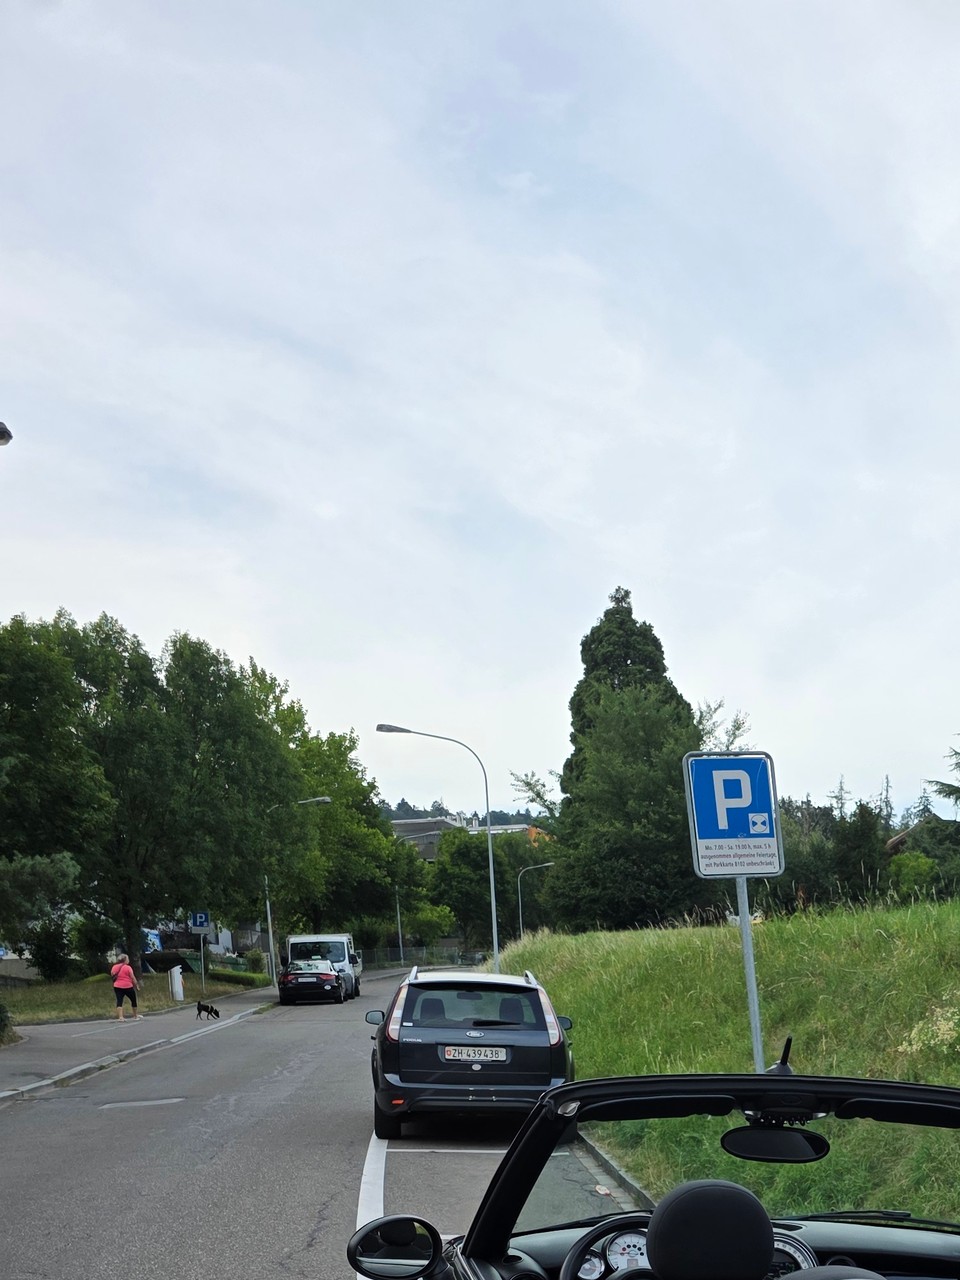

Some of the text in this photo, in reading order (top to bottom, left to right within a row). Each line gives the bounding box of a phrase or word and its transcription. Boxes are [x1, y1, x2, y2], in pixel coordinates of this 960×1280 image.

[712, 770, 752, 830] P
[732, 852, 755, 860] allgemeine
[197, 913, 205, 926] P
